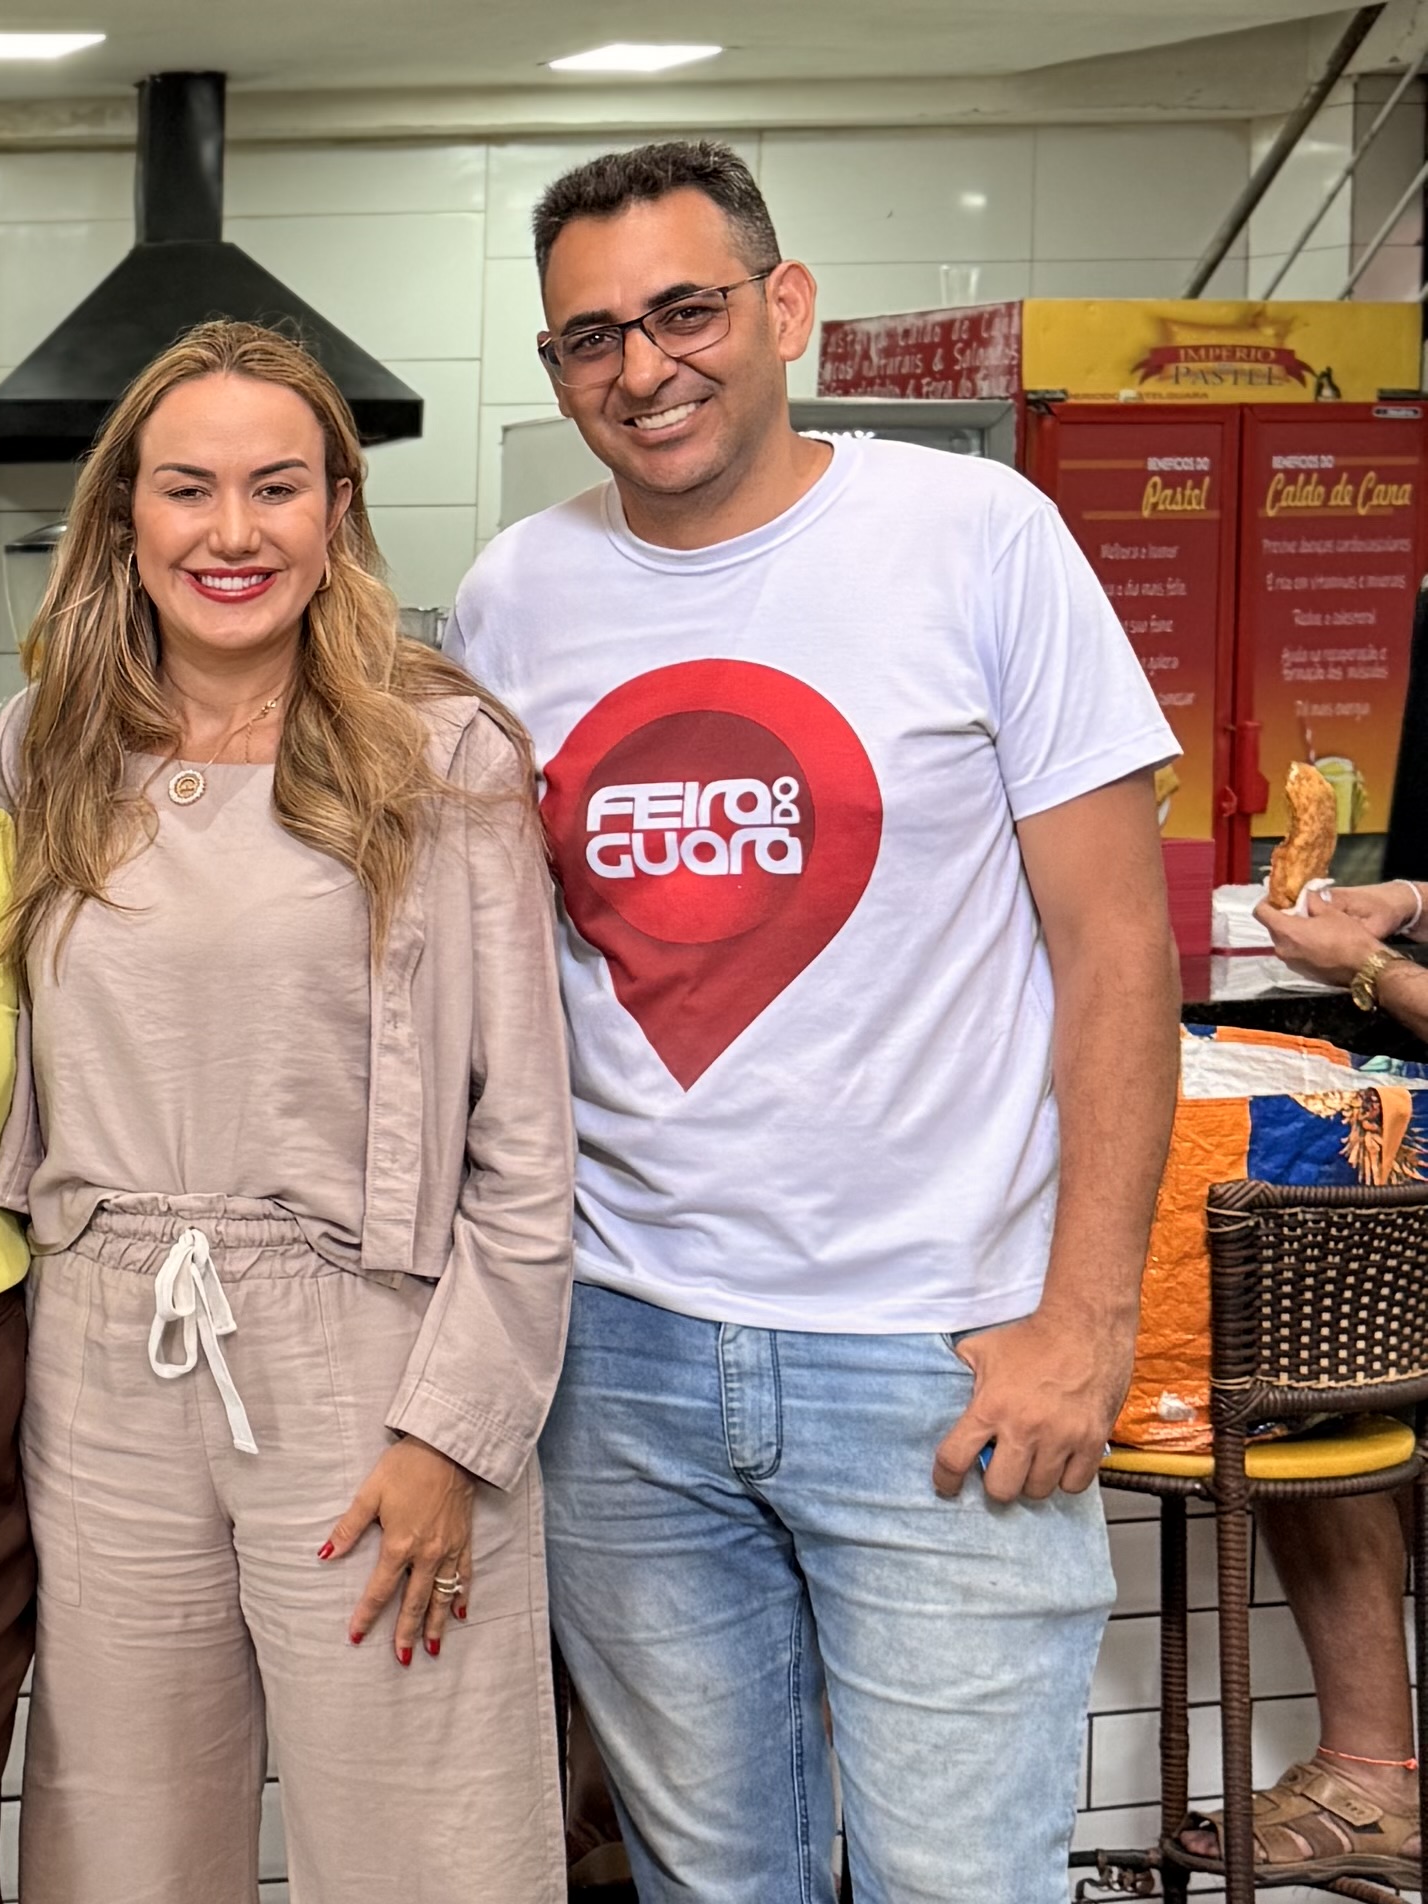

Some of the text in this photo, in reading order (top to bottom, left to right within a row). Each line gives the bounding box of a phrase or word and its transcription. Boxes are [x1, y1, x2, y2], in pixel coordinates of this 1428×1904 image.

[1173, 364, 1287, 386] PASTEL
[1142, 476, 1210, 518] Pastel
[1266, 470, 1412, 517] Caldo de Cana
